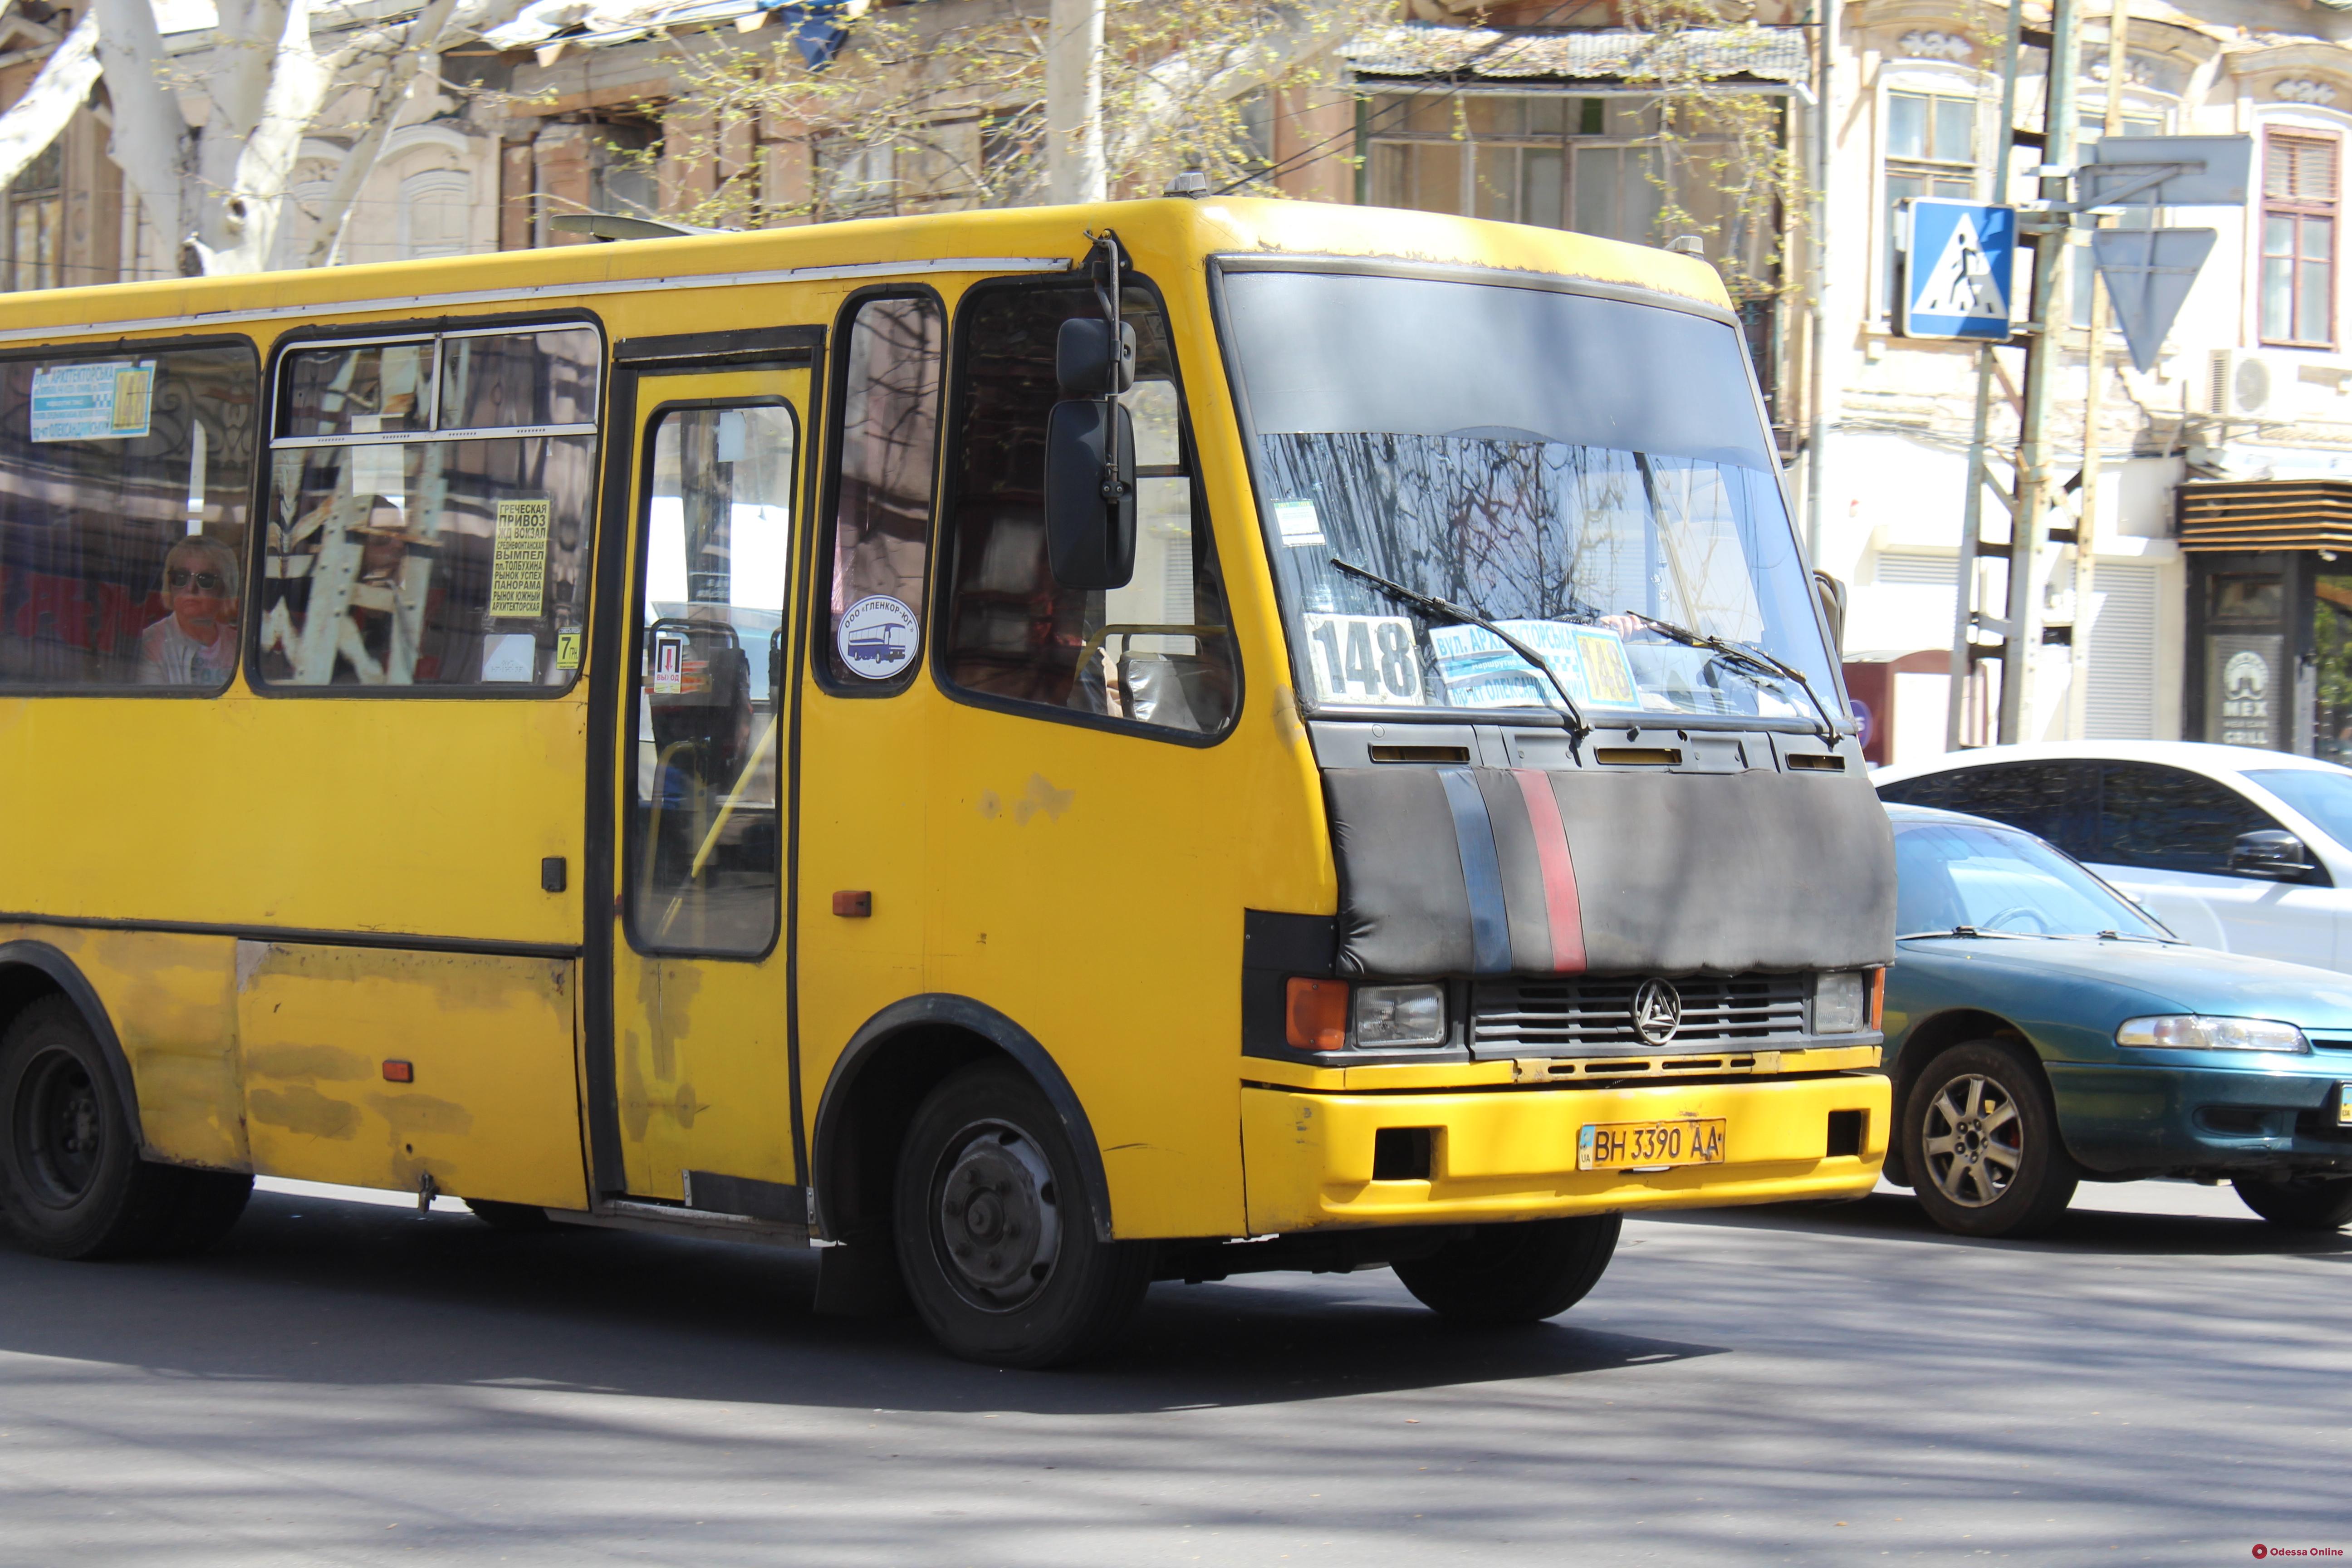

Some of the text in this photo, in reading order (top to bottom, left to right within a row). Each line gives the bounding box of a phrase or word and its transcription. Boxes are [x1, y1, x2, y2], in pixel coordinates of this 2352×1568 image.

[500, 504, 547, 514] ГРЕЧЕСКАЯ
[499, 514, 546, 527] ПРИВОЗ
[498, 527, 546, 540] ЖД ВОКЗАЛ
[497, 541, 544, 551] СРЕДНЕФОНТАНСКАЯ
[496, 551, 544, 560] ВЫМПЕЛ
[495, 571, 542, 580] РЫНОК УСПЕХ
[494, 580, 541, 590] ПАНОРАМА
[493, 590, 540, 602] РЫНОК ЮЖНЫЙ
[492, 602, 540, 612] АРХИТЕКТОРСКАЯ
[845, 609, 860, 628] ООО
[562, 637, 572, 660] 7
[1436, 635, 1469, 661] вул.
[1312, 620, 1417, 697] 148
[1472, 659, 1518, 671] маршрутне
[1579, 637, 1631, 699] 148
[2223, 701, 2268, 717] MEX
[2223, 731, 2268, 745] GRILL
[1631, 1127, 1681, 1160] 3390
[1581, 1153, 1591, 1163] UA
